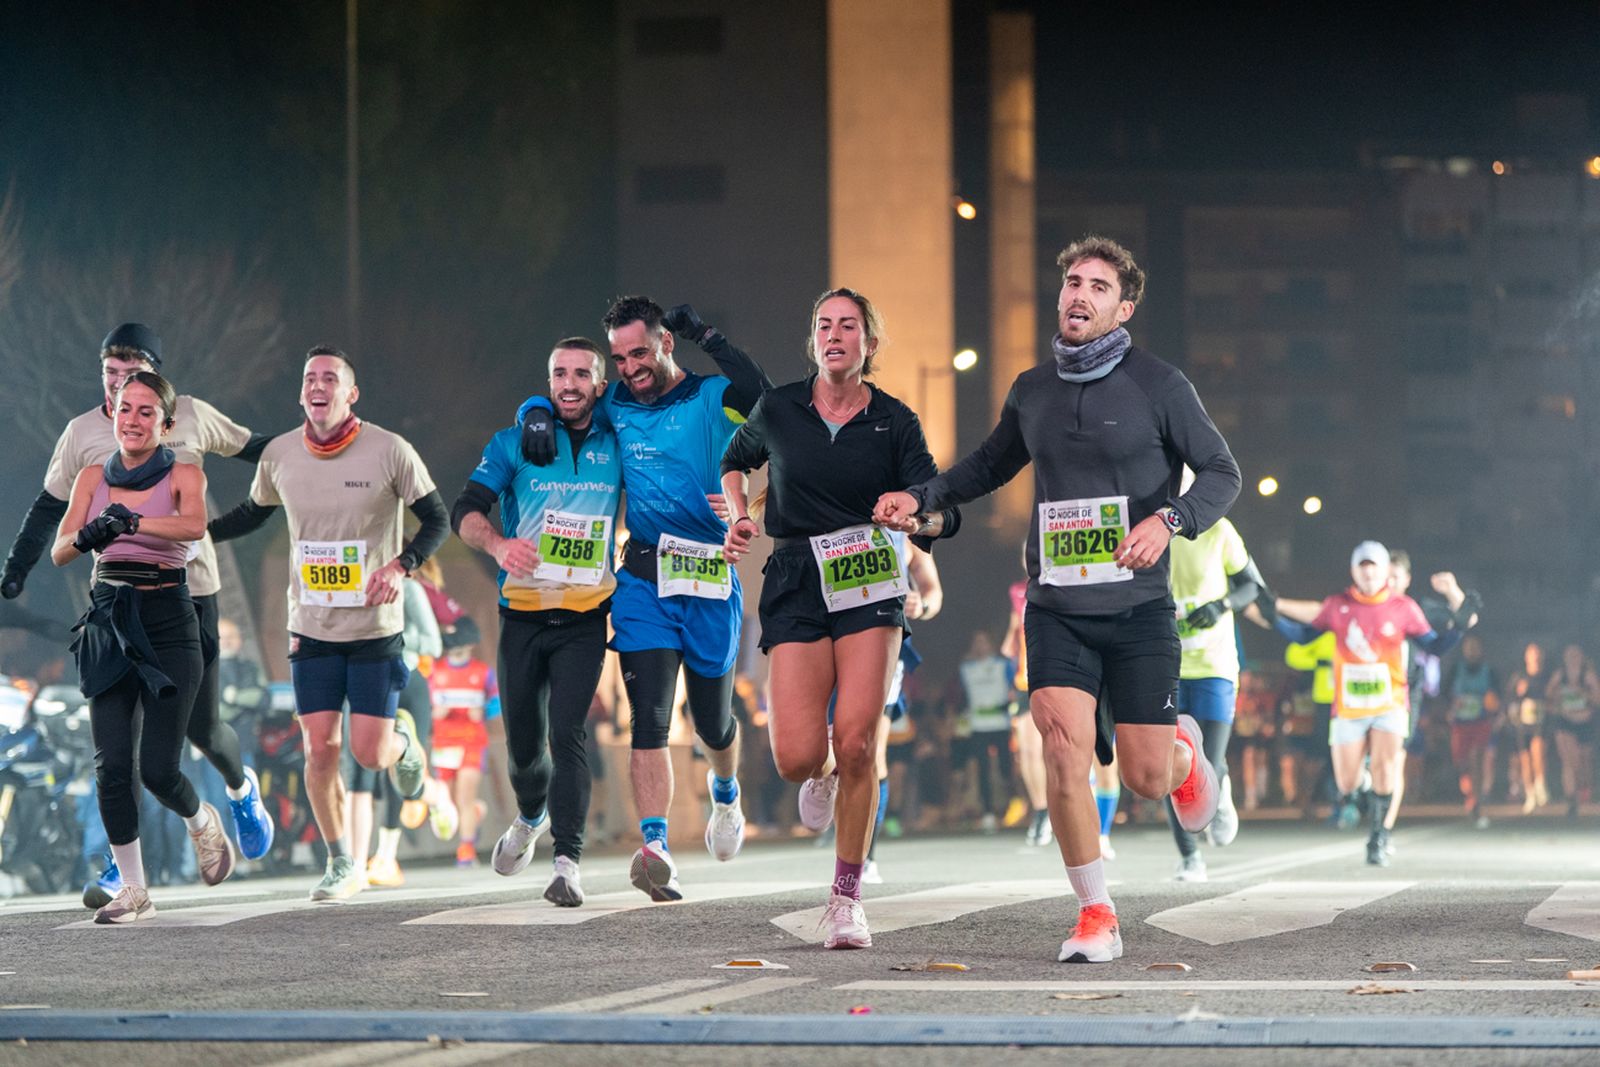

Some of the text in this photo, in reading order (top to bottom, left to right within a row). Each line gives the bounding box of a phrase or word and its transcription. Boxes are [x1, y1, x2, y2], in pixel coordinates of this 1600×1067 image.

[1057, 510, 1080, 519] NOCHE
[1081, 508, 1092, 518] DE
[545, 526, 561, 535] SAN
[555, 520, 587, 530] NOCHE DE
[1049, 521, 1065, 531] SAN
[832, 535, 856, 548] NOCHE
[856, 533, 866, 541] DE
[1050, 528, 1119, 557] 13626
[550, 536, 594, 560] 7358
[676, 546, 698, 556] NOCHE
[825, 549, 843, 559] SAN
[829, 548, 892, 583] 12393
[310, 565, 350, 584] 5189
